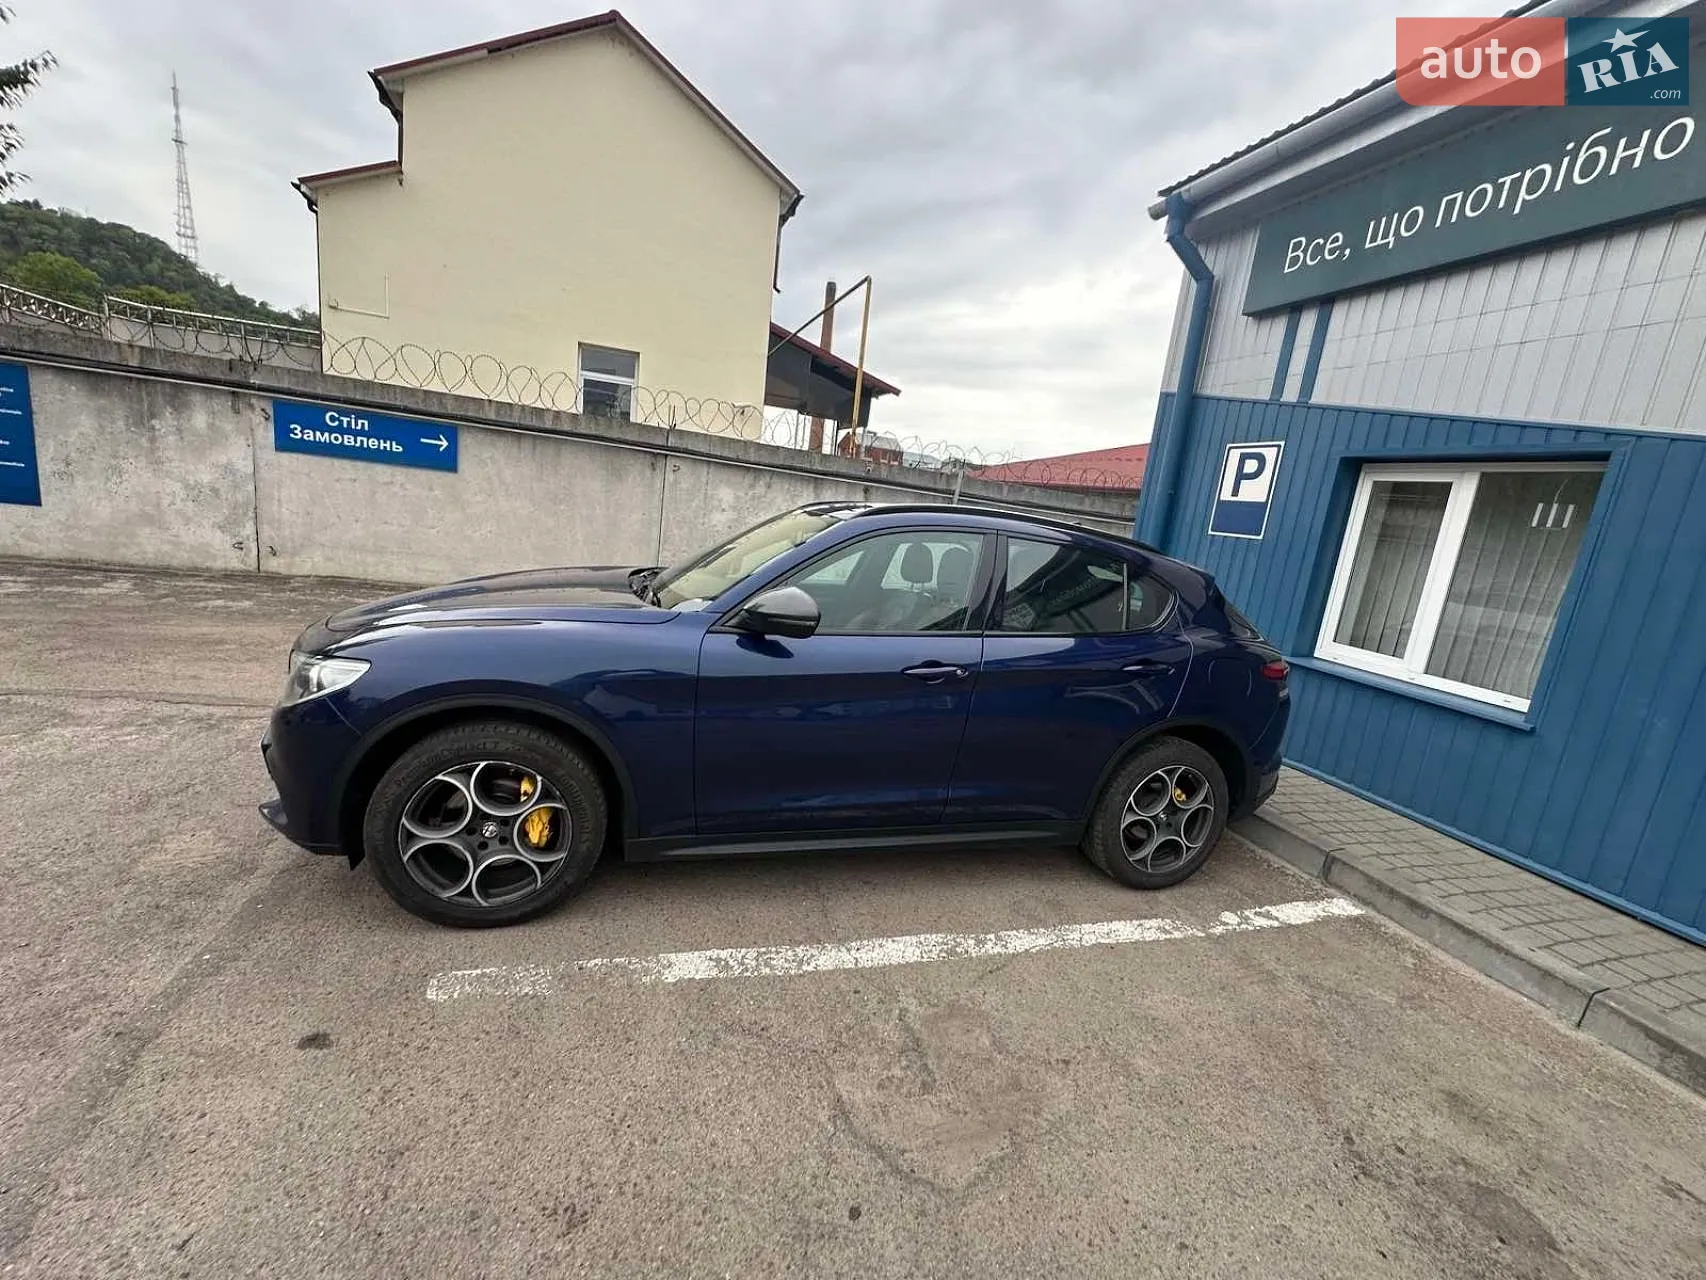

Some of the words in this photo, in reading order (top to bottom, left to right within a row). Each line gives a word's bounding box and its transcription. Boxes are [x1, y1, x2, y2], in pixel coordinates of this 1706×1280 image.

[1283, 232, 1350, 273] Все,
[1364, 204, 1424, 249] що
[1434, 116, 1696, 228] потрібно
[289, 423, 404, 453] Замовлень
[324, 411, 370, 431] Стіл
[1231, 451, 1267, 498] P
